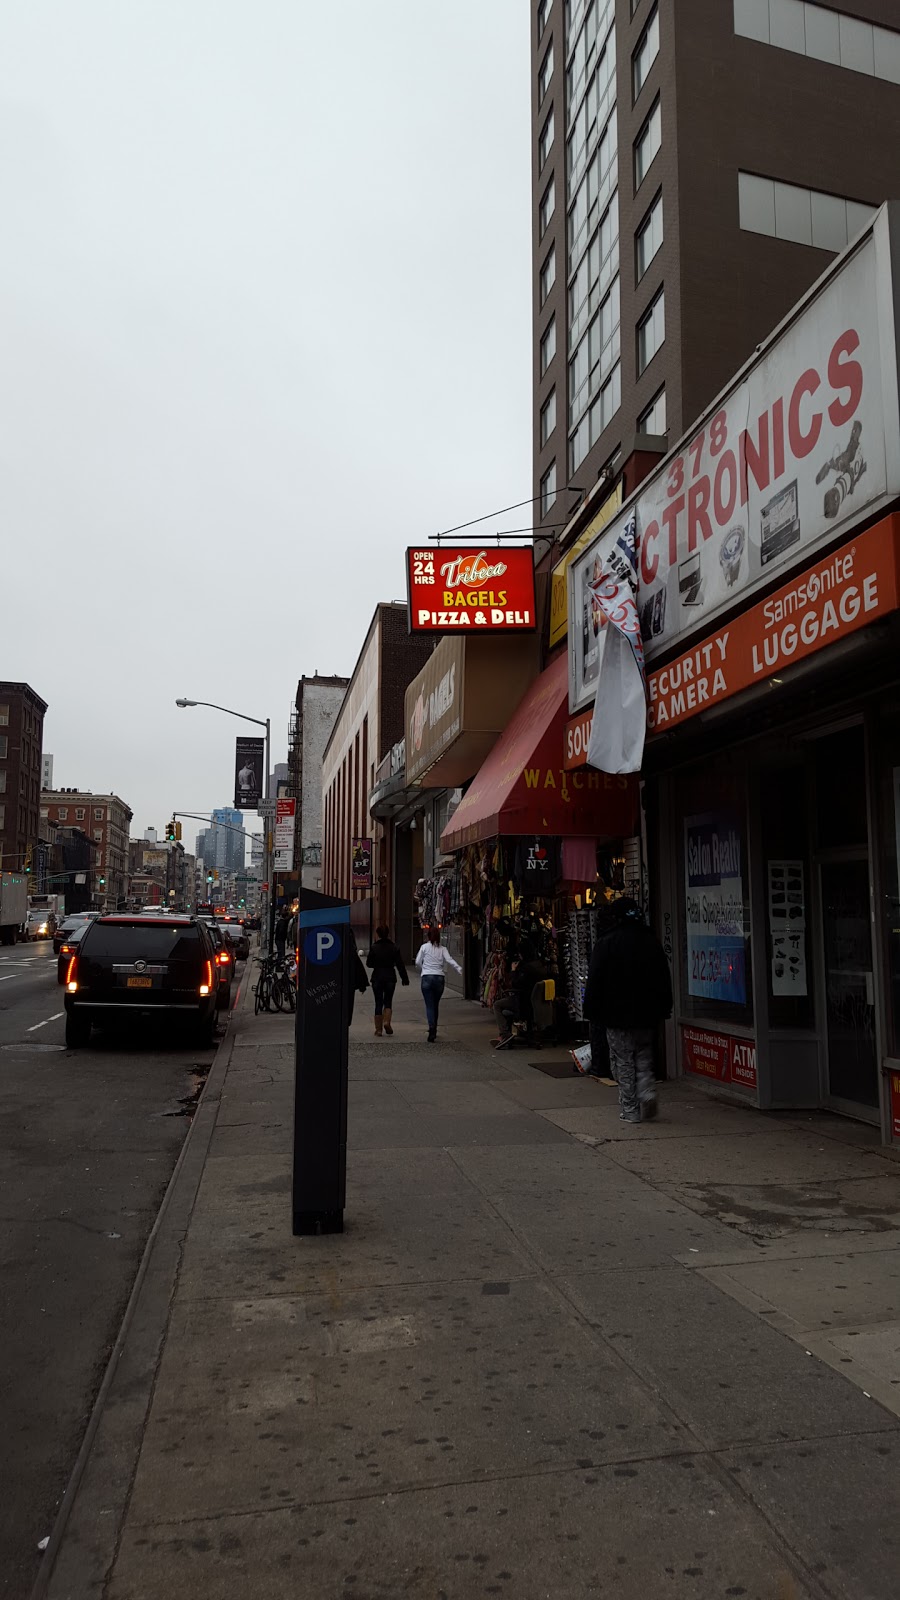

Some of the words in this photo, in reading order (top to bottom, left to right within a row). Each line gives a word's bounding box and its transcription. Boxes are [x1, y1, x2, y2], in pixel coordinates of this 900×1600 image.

[635, 328, 864, 592] CTRONICS
[666, 409, 728, 498] 378
[413, 552, 434, 561] OPEN
[413, 561, 435, 576] 24
[440, 551, 508, 588] Tribeca
[414, 576, 435, 585] HRS
[443, 590, 507, 607] BAGELS
[418, 609, 471, 625] PIZZA
[474, 610, 488, 624] &
[491, 608, 530, 625] DELI
[751, 572, 879, 674] LUGGAGE
[649, 631, 730, 702] ECURITY
[647, 668, 728, 729] CAMERA
[567, 720, 590, 760] SOU
[523, 768, 628, 791] WATCHES
[688, 834, 711, 876] Salon
[712, 829, 741, 878] Realty
[733, 1044, 757, 1070] ATM
[735, 1066, 755, 1080] INSIDE
